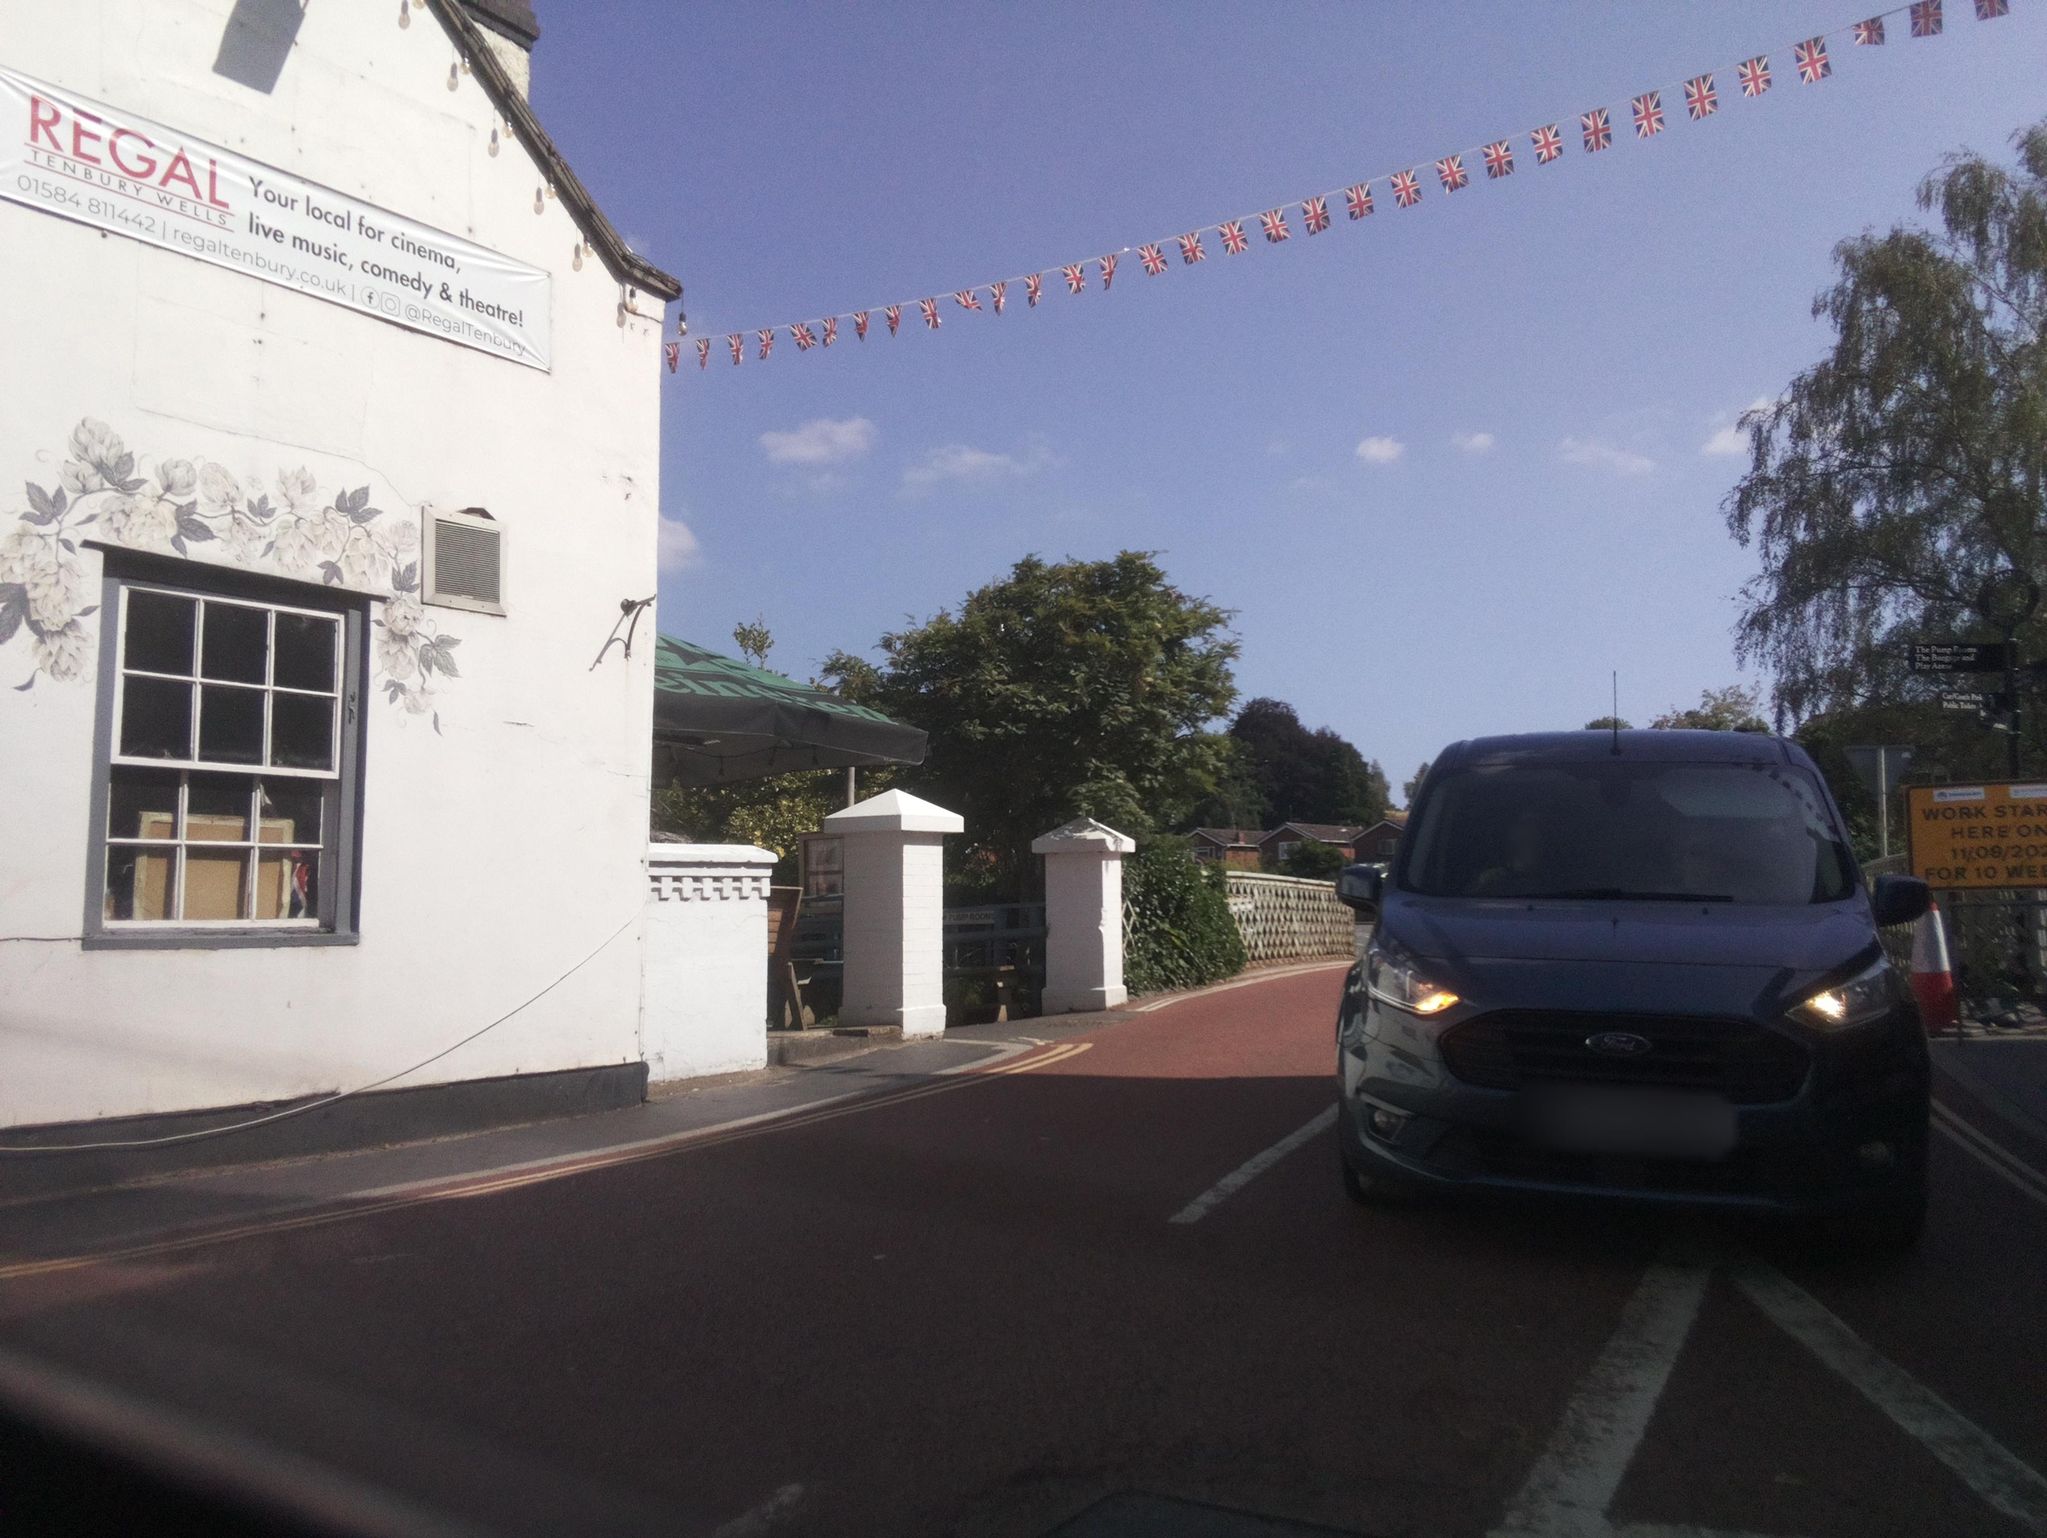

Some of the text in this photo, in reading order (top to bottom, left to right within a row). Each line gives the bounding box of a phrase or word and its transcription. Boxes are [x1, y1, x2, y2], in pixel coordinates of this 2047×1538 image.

[30, 94, 229, 210] REGAL
[32, 150, 227, 226] TENBURY WELLS
[249, 176, 461, 274] Your local for cinema,
[17, 174, 82, 208] 01584
[88, 198, 155, 233] 811442
[173, 226, 347, 296] regaltenbury.co.uk
[405, 304, 527, 356] @RegalTenbury
[249, 212, 524, 328] live music, comedy & theatre!
[655, 671, 900, 725] eineken
[1923, 806, 1986, 820] WORK
[1951, 824, 2047, 839] HERE ON
[1925, 867, 1967, 880] FOR
[1974, 866, 1997, 879] 10
